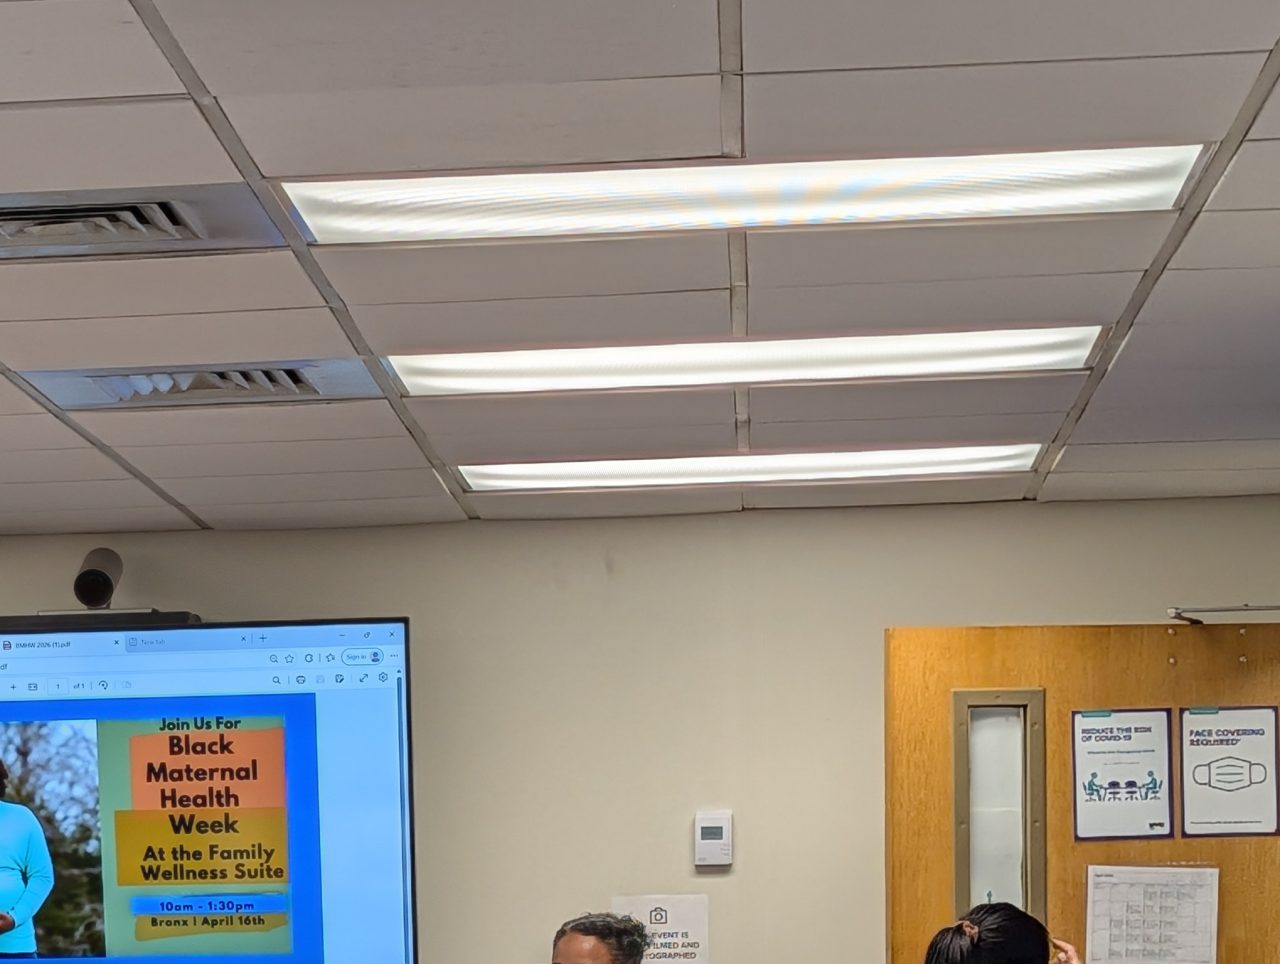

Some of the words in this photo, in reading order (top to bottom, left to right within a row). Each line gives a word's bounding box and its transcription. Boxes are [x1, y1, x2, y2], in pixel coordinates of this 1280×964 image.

[159, 718, 190, 732] Join
[194, 717, 212, 730] Us
[215, 716, 241, 729] For
[1190, 729, 1213, 737] FACE
[168, 734, 234, 756] Black
[146, 760, 258, 782] Maternal
[160, 786, 240, 808] Health
[168, 813, 239, 834] Week
[143, 846, 166, 862] At
[172, 844, 202, 861] the
[208, 843, 275, 864] Family
[141, 864, 228, 880] Wellness
[234, 863, 284, 879] Suite
[160, 902, 194, 912] 10am
[208, 901, 254, 912] 1:30pm
[151, 917, 189, 927] Bronx
[201, 916, 234, 928] April
[238, 914, 265, 926] 16th
[645, 952, 697, 960] TOGRAPHED
